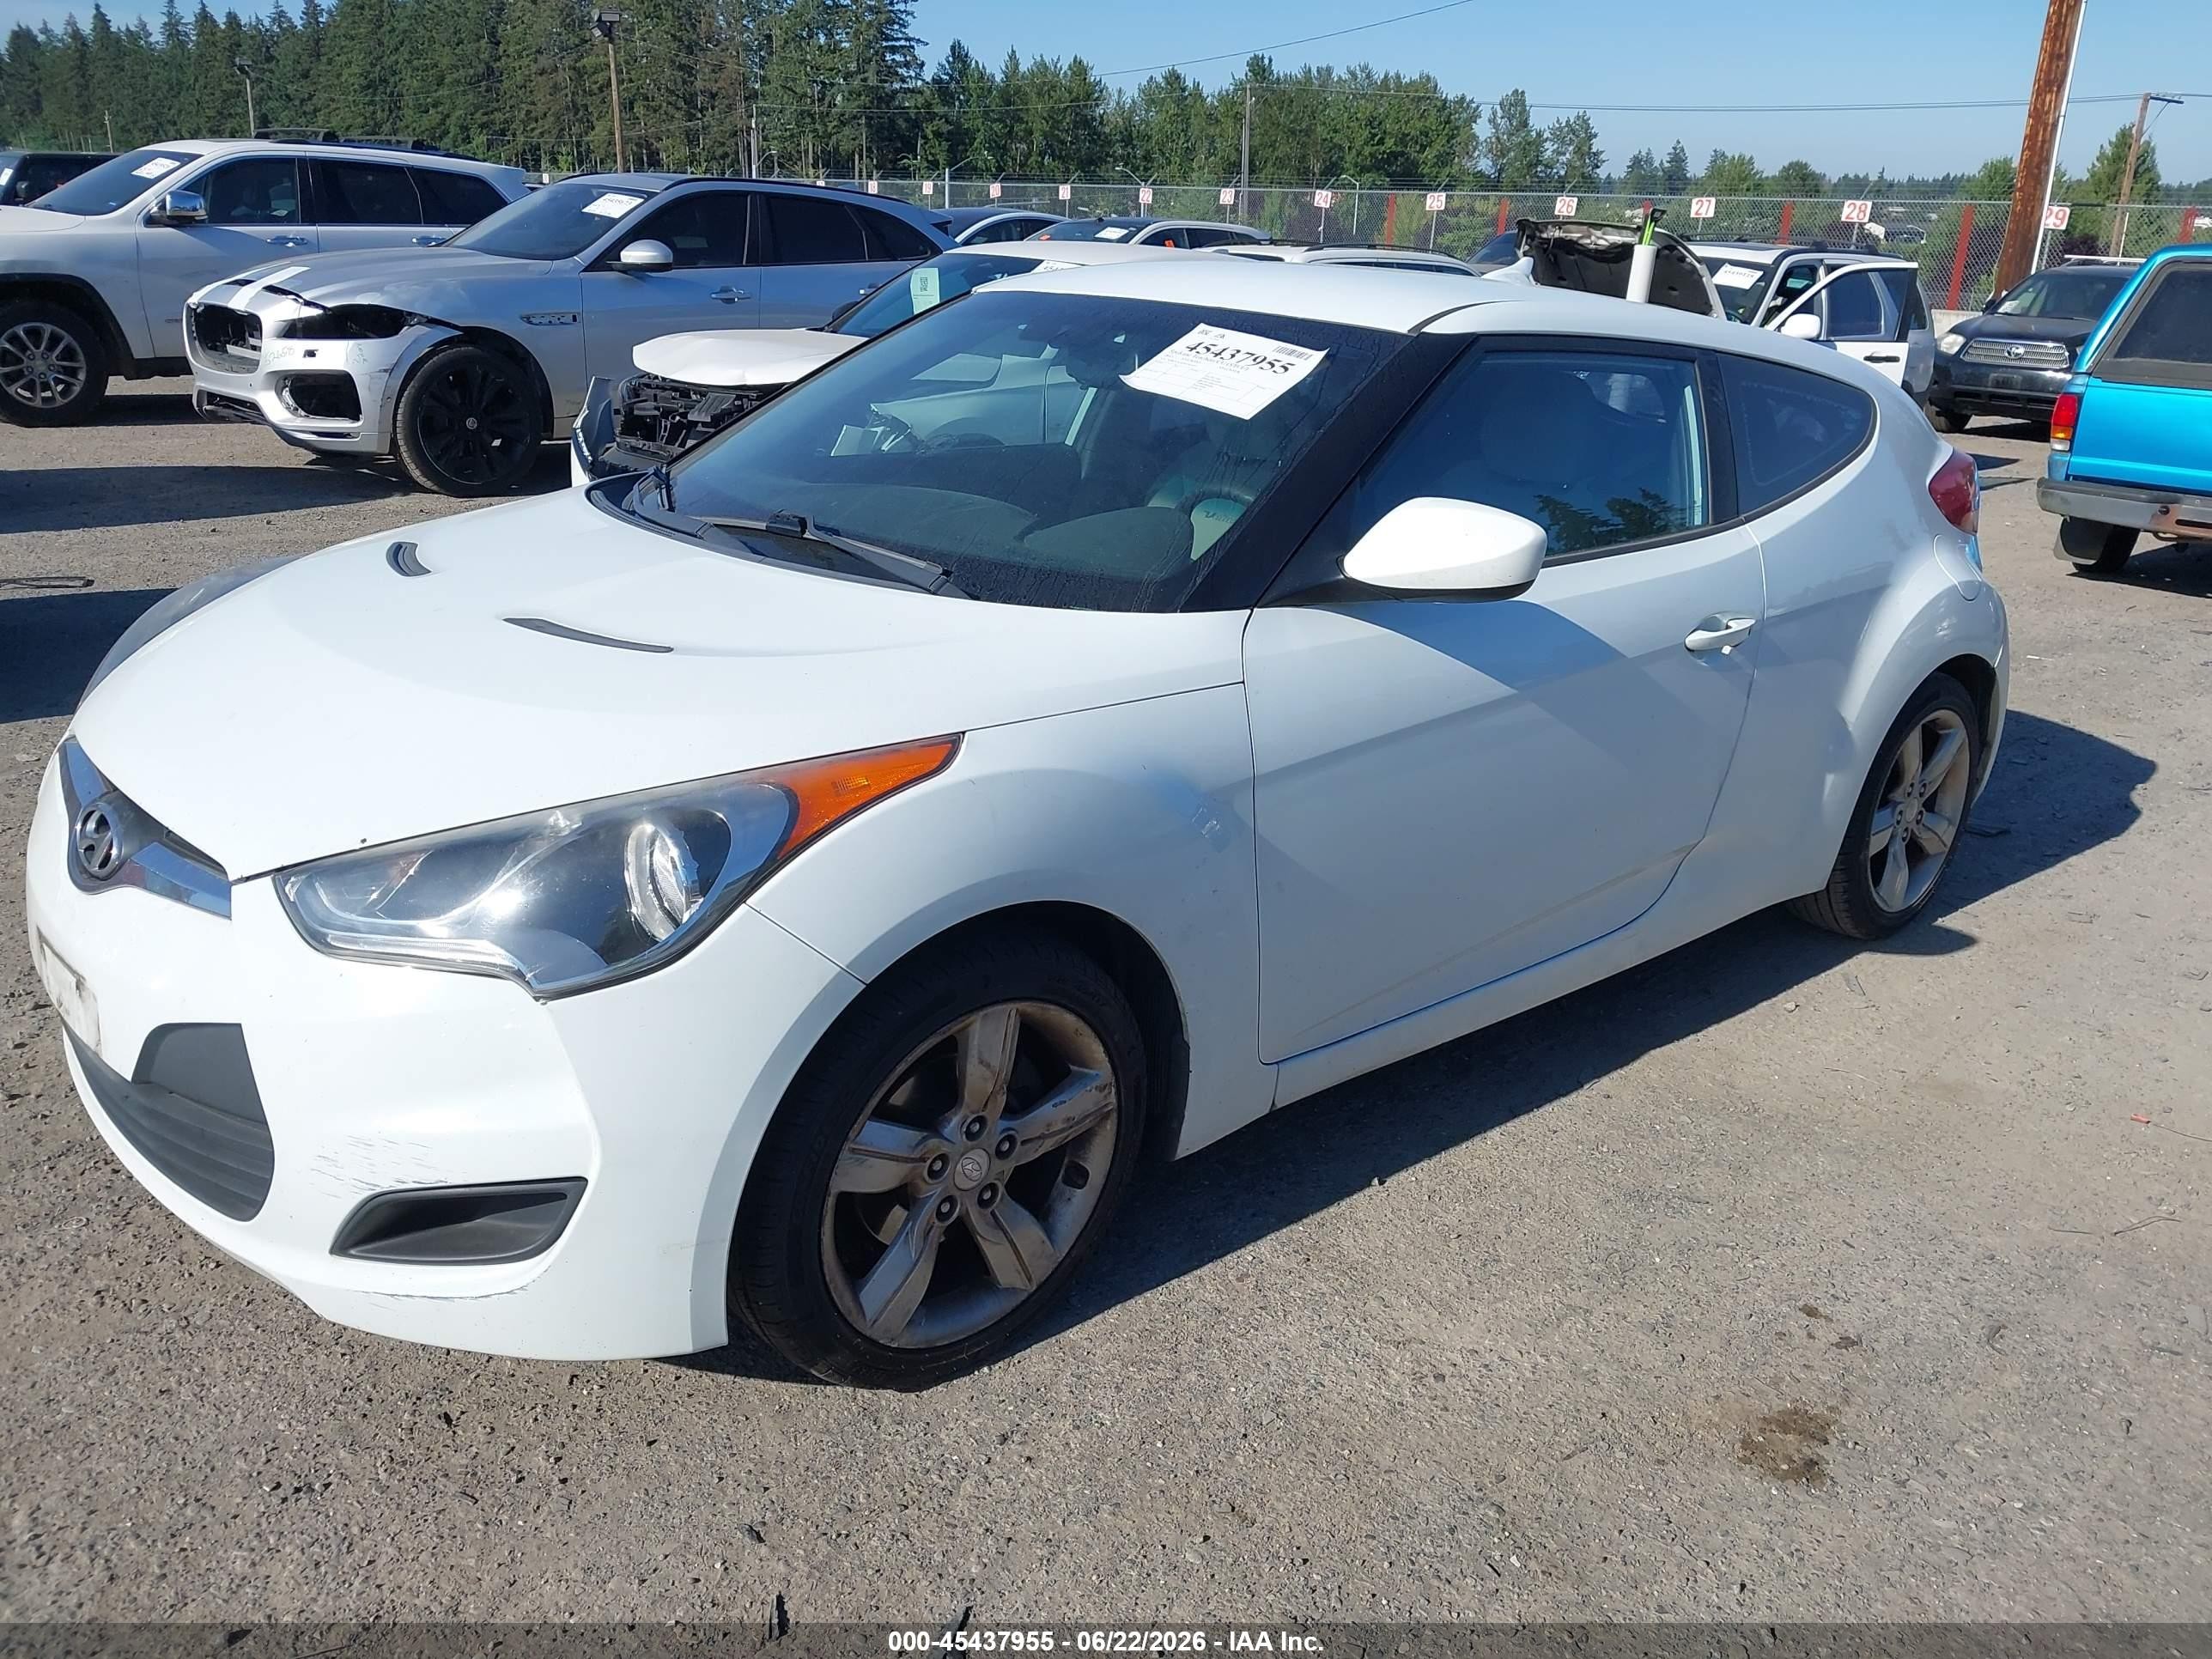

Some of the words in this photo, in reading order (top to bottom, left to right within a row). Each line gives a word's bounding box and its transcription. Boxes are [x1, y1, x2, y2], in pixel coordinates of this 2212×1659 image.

[870, 182, 876, 192] 18
[925, 183, 932, 193] 19
[991, 185, 1000, 197] 20
[1061, 186, 1069, 198] 21
[1140, 190, 1152, 202] 22
[1222, 190, 1232, 203] 23
[1316, 191, 1328, 206] 24
[1428, 194, 1443, 209] 25
[1558, 198, 1575, 214] 26
[1695, 199, 1712, 216] 27
[1845, 202, 1868, 221] 28
[1186, 342, 1296, 374] 45437955
